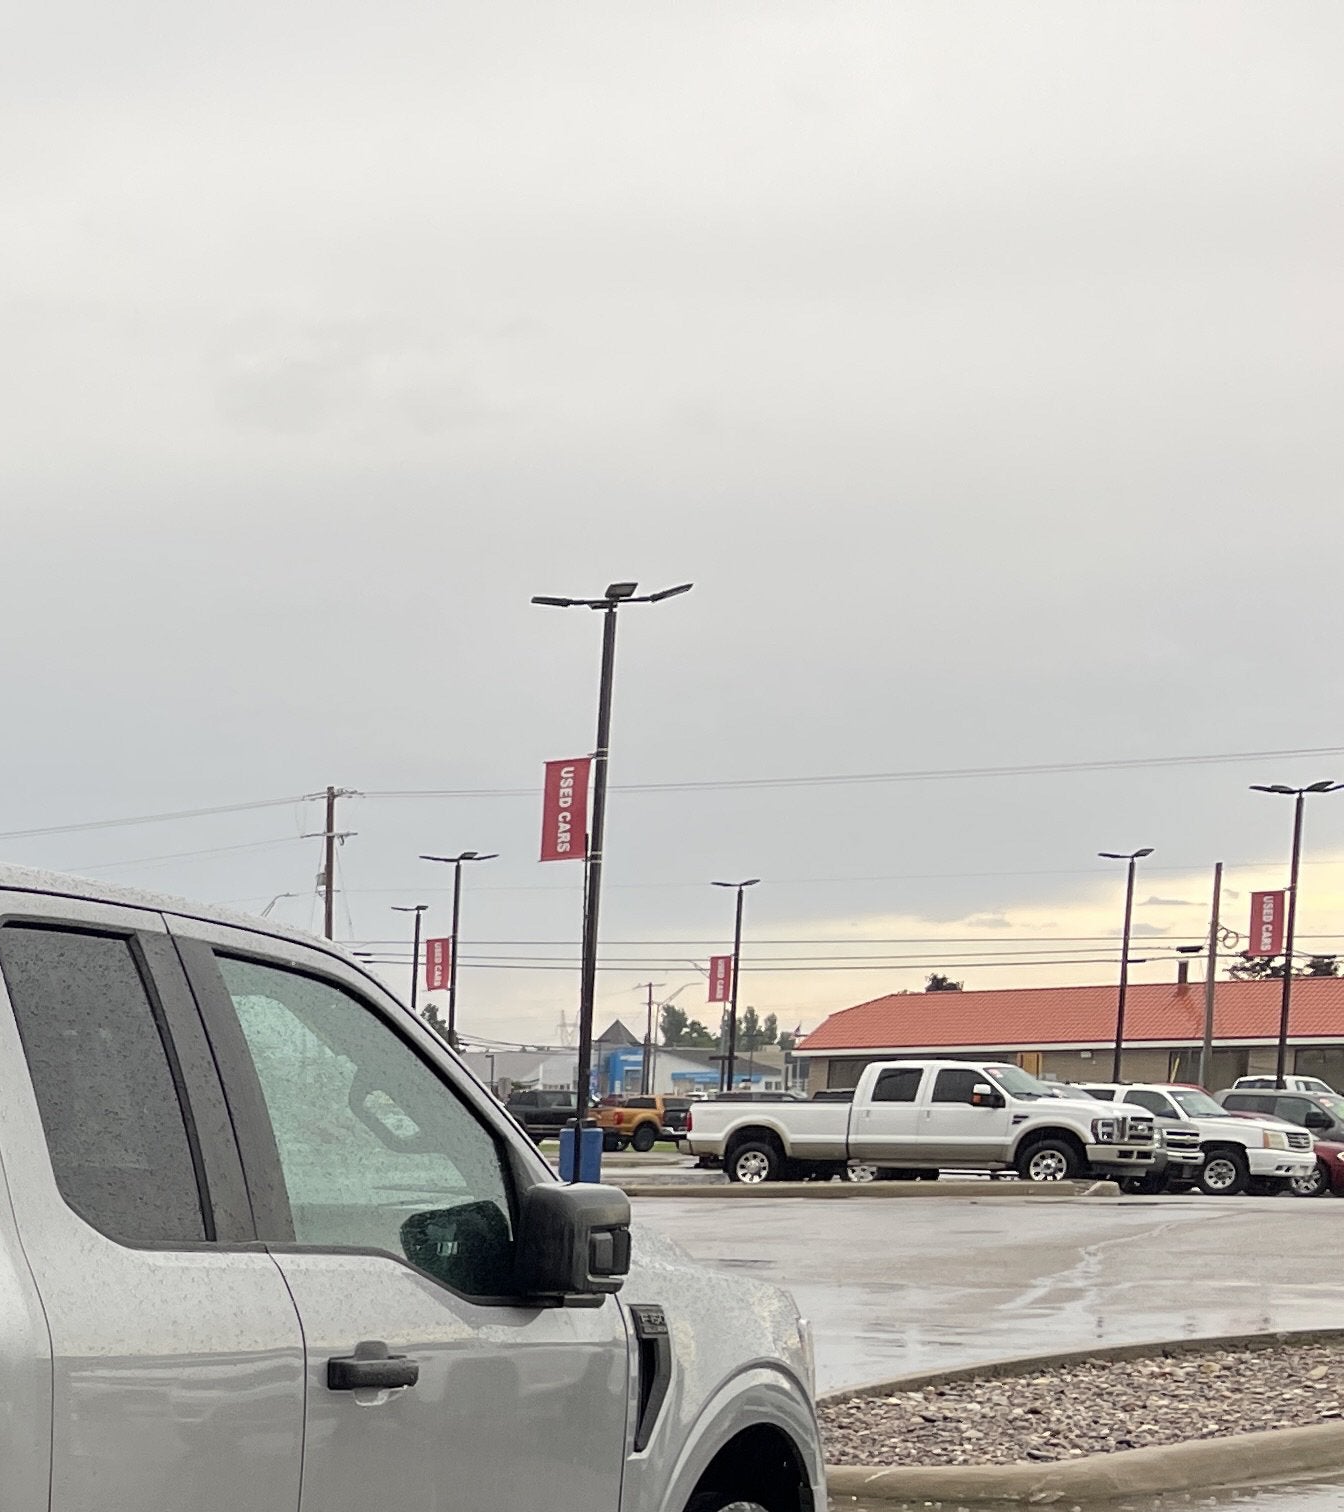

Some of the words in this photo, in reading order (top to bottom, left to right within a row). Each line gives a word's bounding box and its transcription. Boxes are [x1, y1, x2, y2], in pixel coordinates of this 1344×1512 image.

[558, 766, 575, 808] USED
[556, 811, 572, 853] CARS
[1262, 895, 1274, 922] USED
[1260, 923, 1273, 951] CARS
